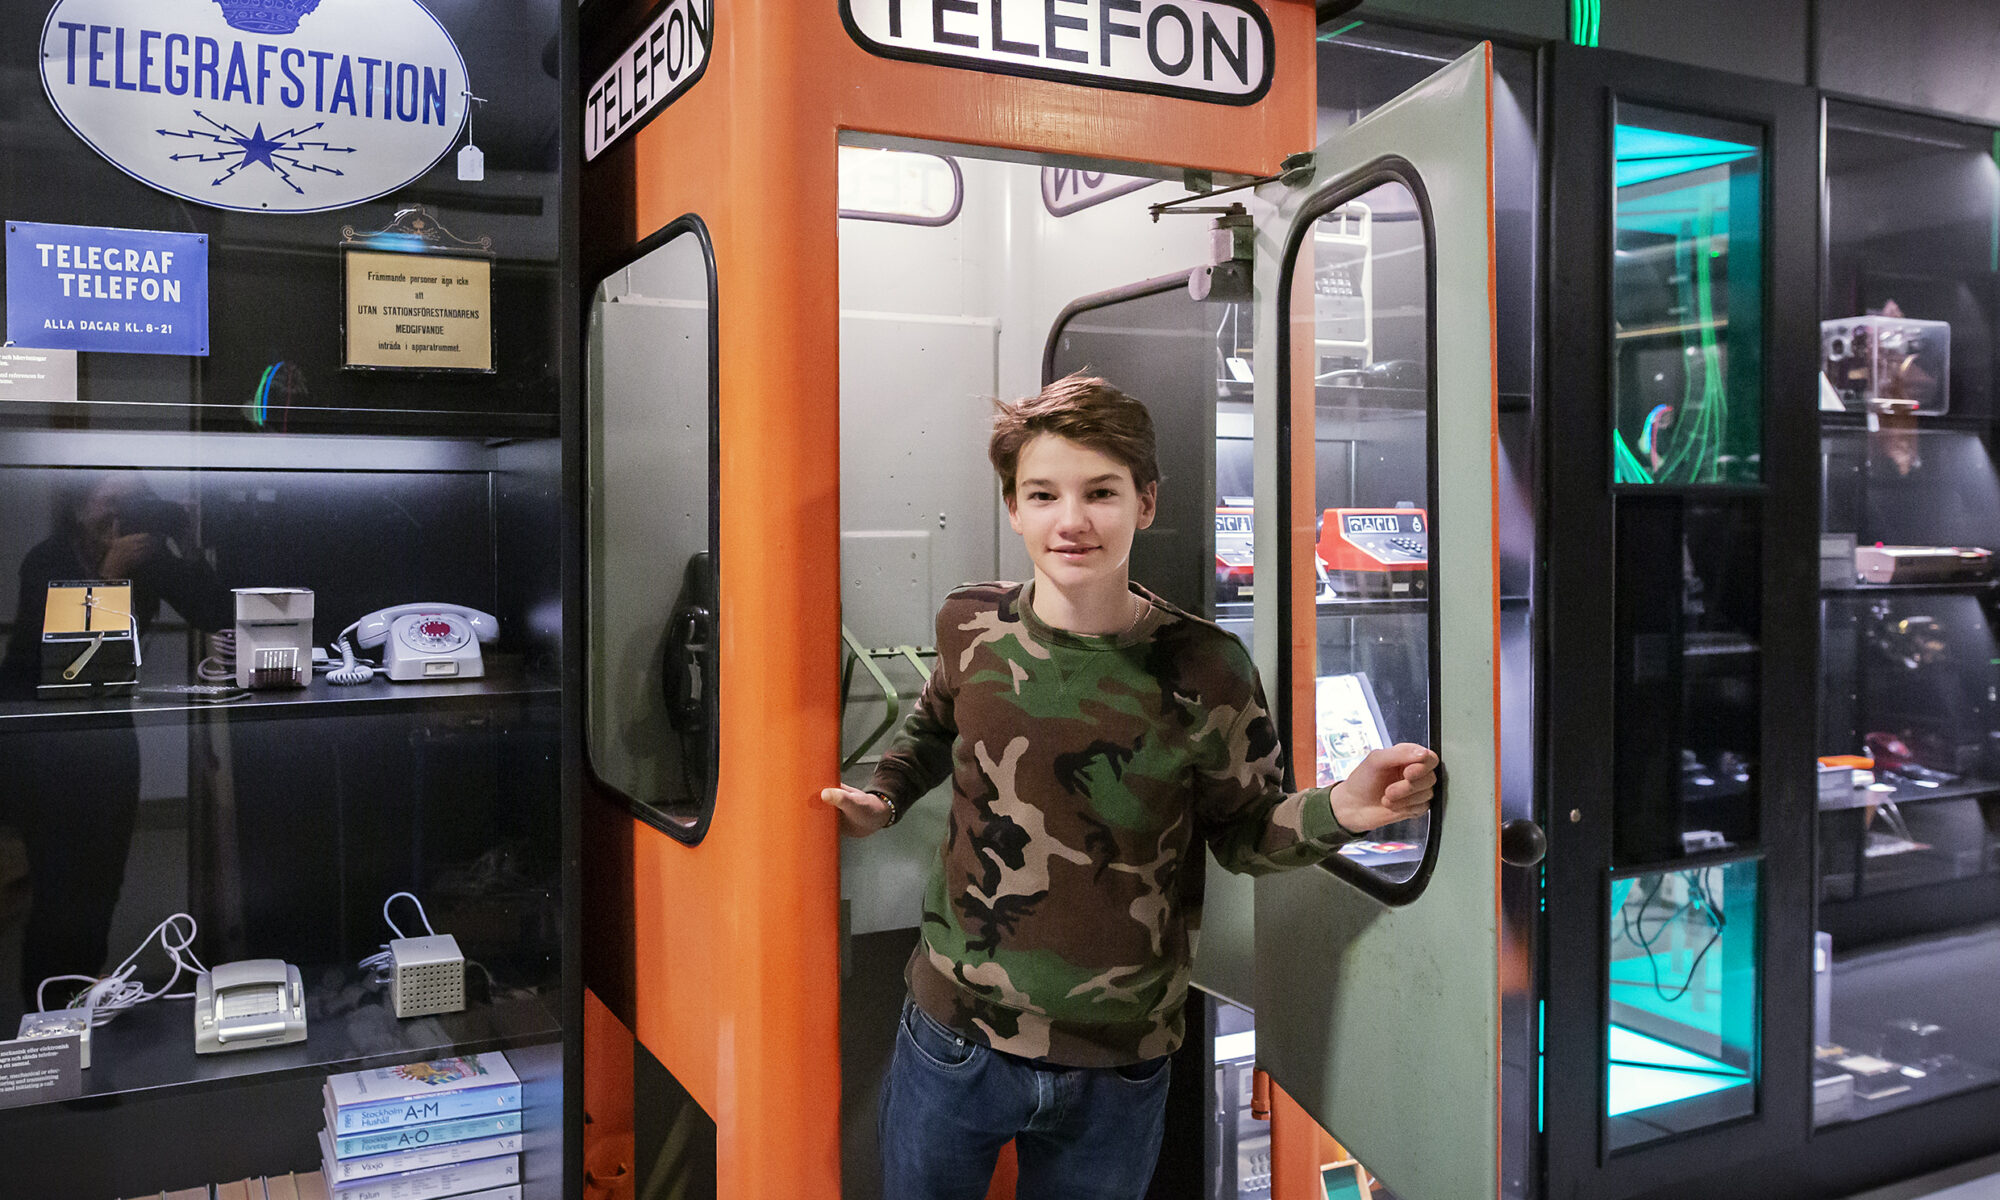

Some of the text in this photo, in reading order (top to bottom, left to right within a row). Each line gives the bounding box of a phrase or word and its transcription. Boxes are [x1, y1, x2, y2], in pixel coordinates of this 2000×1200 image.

[58, 21, 447, 127] TELEGRAFSTATION
[589, 0, 708, 151] TELEFON
[36, 243, 174, 274] TELEGRAF
[367, 271, 406, 282] Främmande
[410, 275, 437, 284] personer
[58, 273, 181, 303] TELEFON
[415, 292, 424, 300] att
[358, 305, 377, 315] UTAN
[44, 319, 75, 330] ALLA
[80, 320, 120, 332] DAGAR
[396, 324, 444, 335] MEDGIFVANDE
[378, 341, 401, 351] inträda
[362, 1102, 438, 1120] Stockholm A-M
